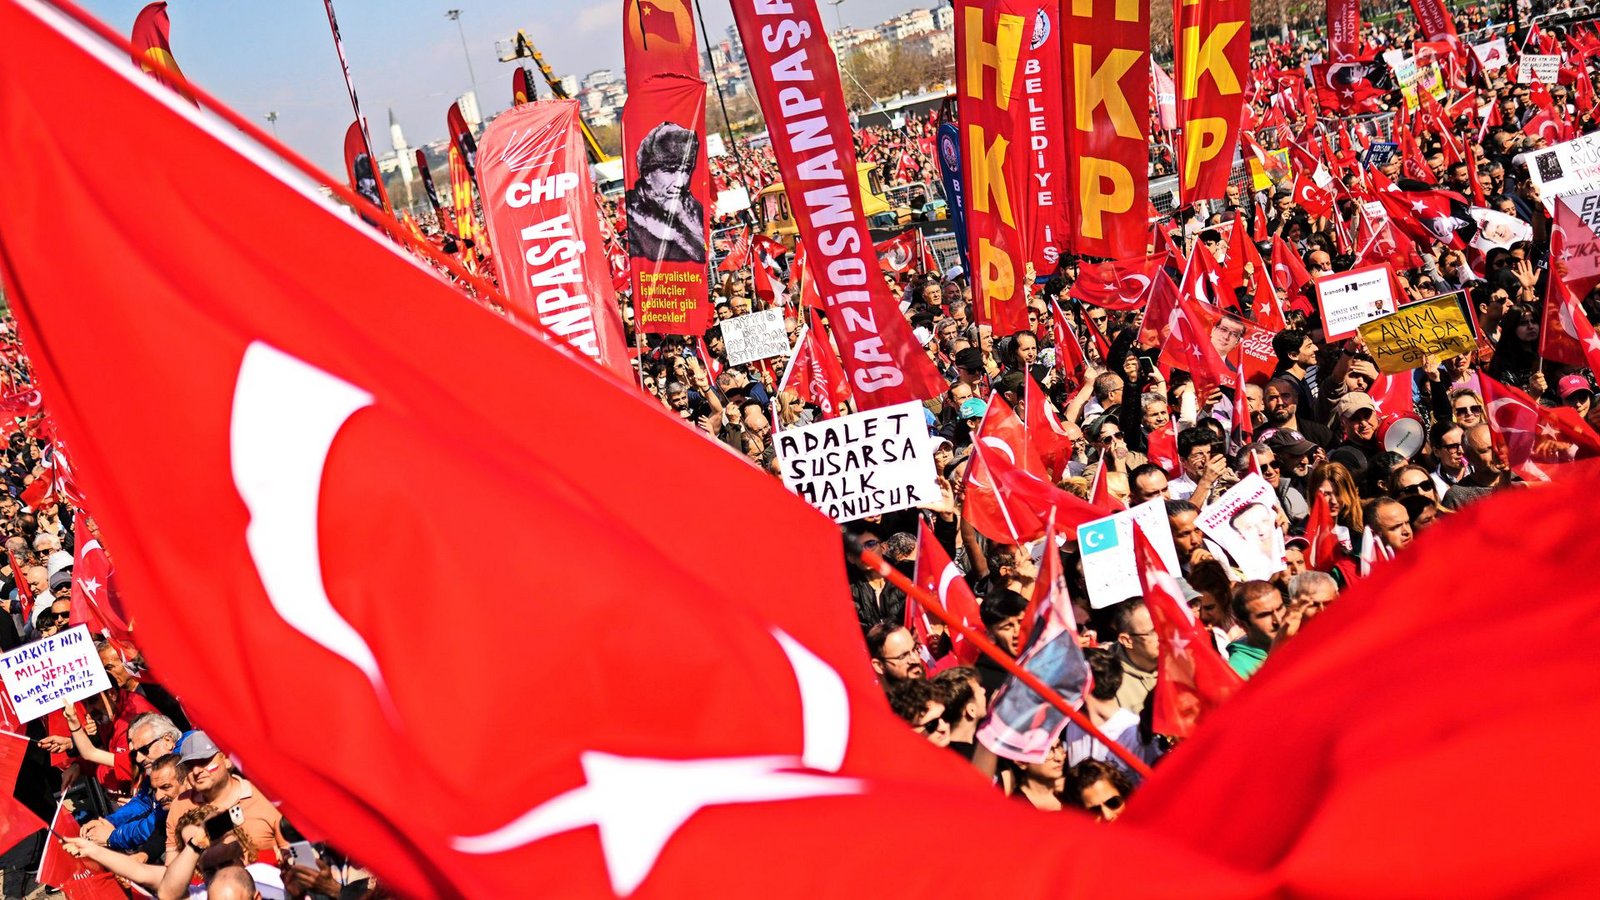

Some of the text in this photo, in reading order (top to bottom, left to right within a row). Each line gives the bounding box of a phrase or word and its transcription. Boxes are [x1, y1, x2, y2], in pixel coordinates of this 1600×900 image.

[1334, 21, 1342, 43] CHP
[1347, 10, 1355, 44] KADIN
[1181, 0, 1246, 191] KP
[1023, 59, 1053, 207] BELEDİYE
[1071, 0, 1145, 241] KP
[505, 172, 580, 208] CHP
[521, 213, 603, 366] ANPAŞA
[640, 271, 702, 285] Emperyalistler,
[680, 299, 697, 312] gibi
[1381, 307, 1439, 342] ANAMI
[1432, 321, 1458, 340] DA
[1244, 348, 1269, 362] olacak
[780, 413, 909, 458] ADALET
[789, 437, 917, 480] SUSARSA
[795, 471, 877, 503] HALK
[818, 484, 921, 519] ONUSUR
